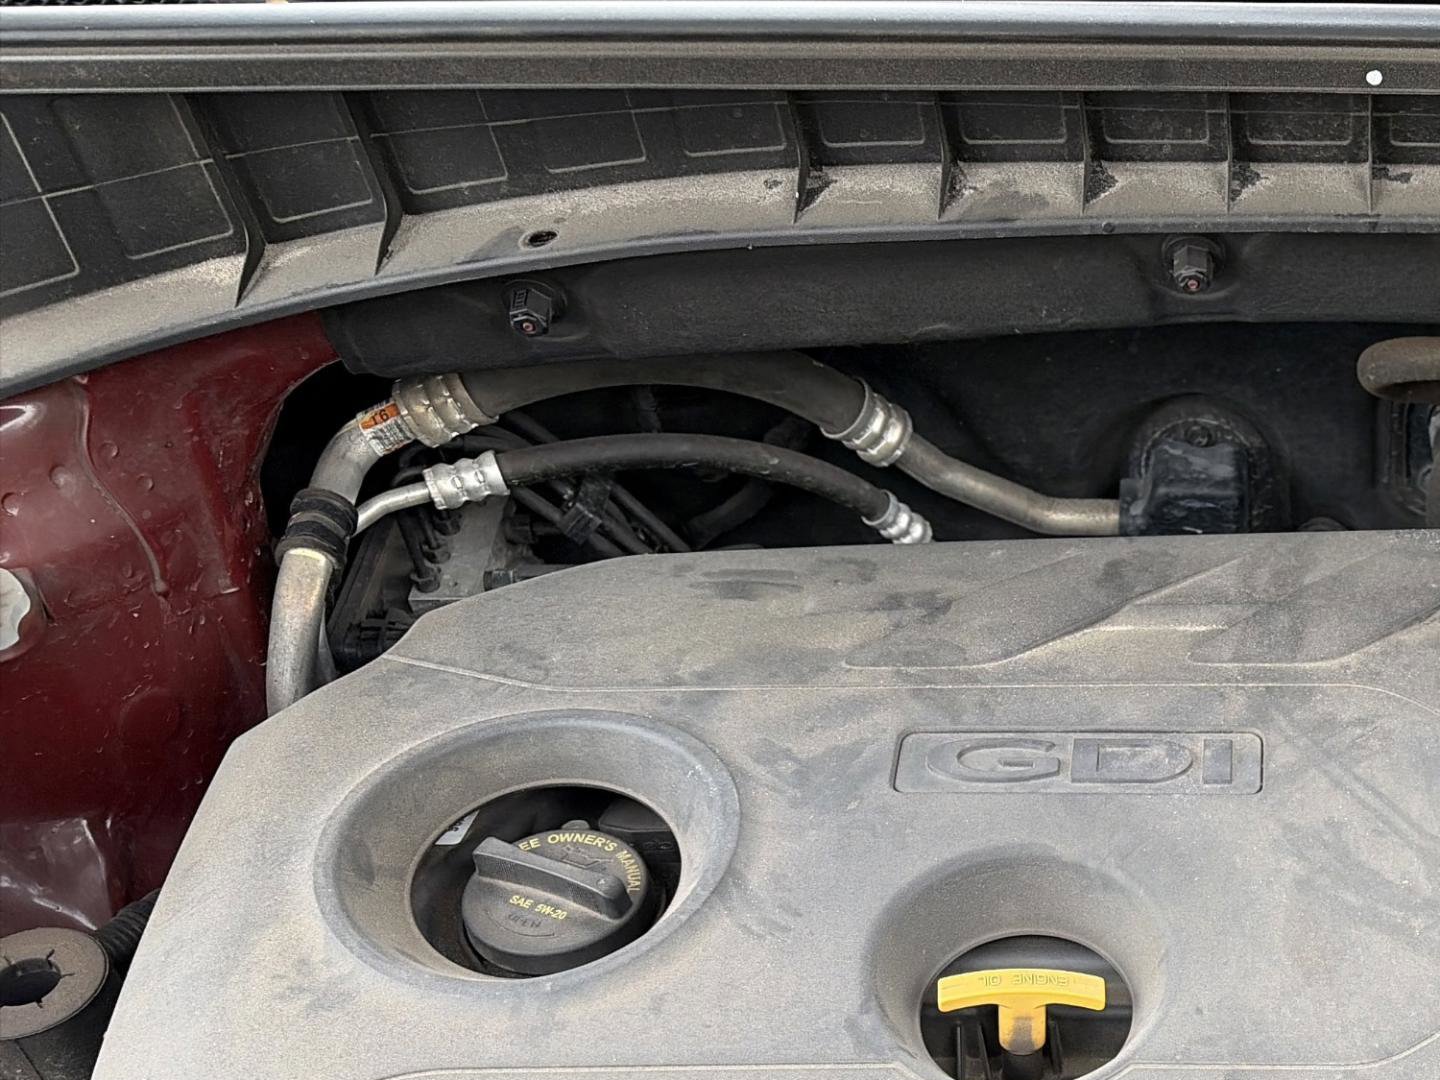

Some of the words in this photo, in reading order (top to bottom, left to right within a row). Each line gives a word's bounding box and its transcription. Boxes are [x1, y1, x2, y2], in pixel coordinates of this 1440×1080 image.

[925, 738, 1233, 784] GDI
[518, 838, 541, 852] EE
[547, 832, 618, 852] OWNER'S
[615, 850, 642, 893] MANUAL
[509, 895, 534, 909] SAE
[535, 903, 568, 920] 5W-20
[1012, 973, 1070, 987] ENGINE
